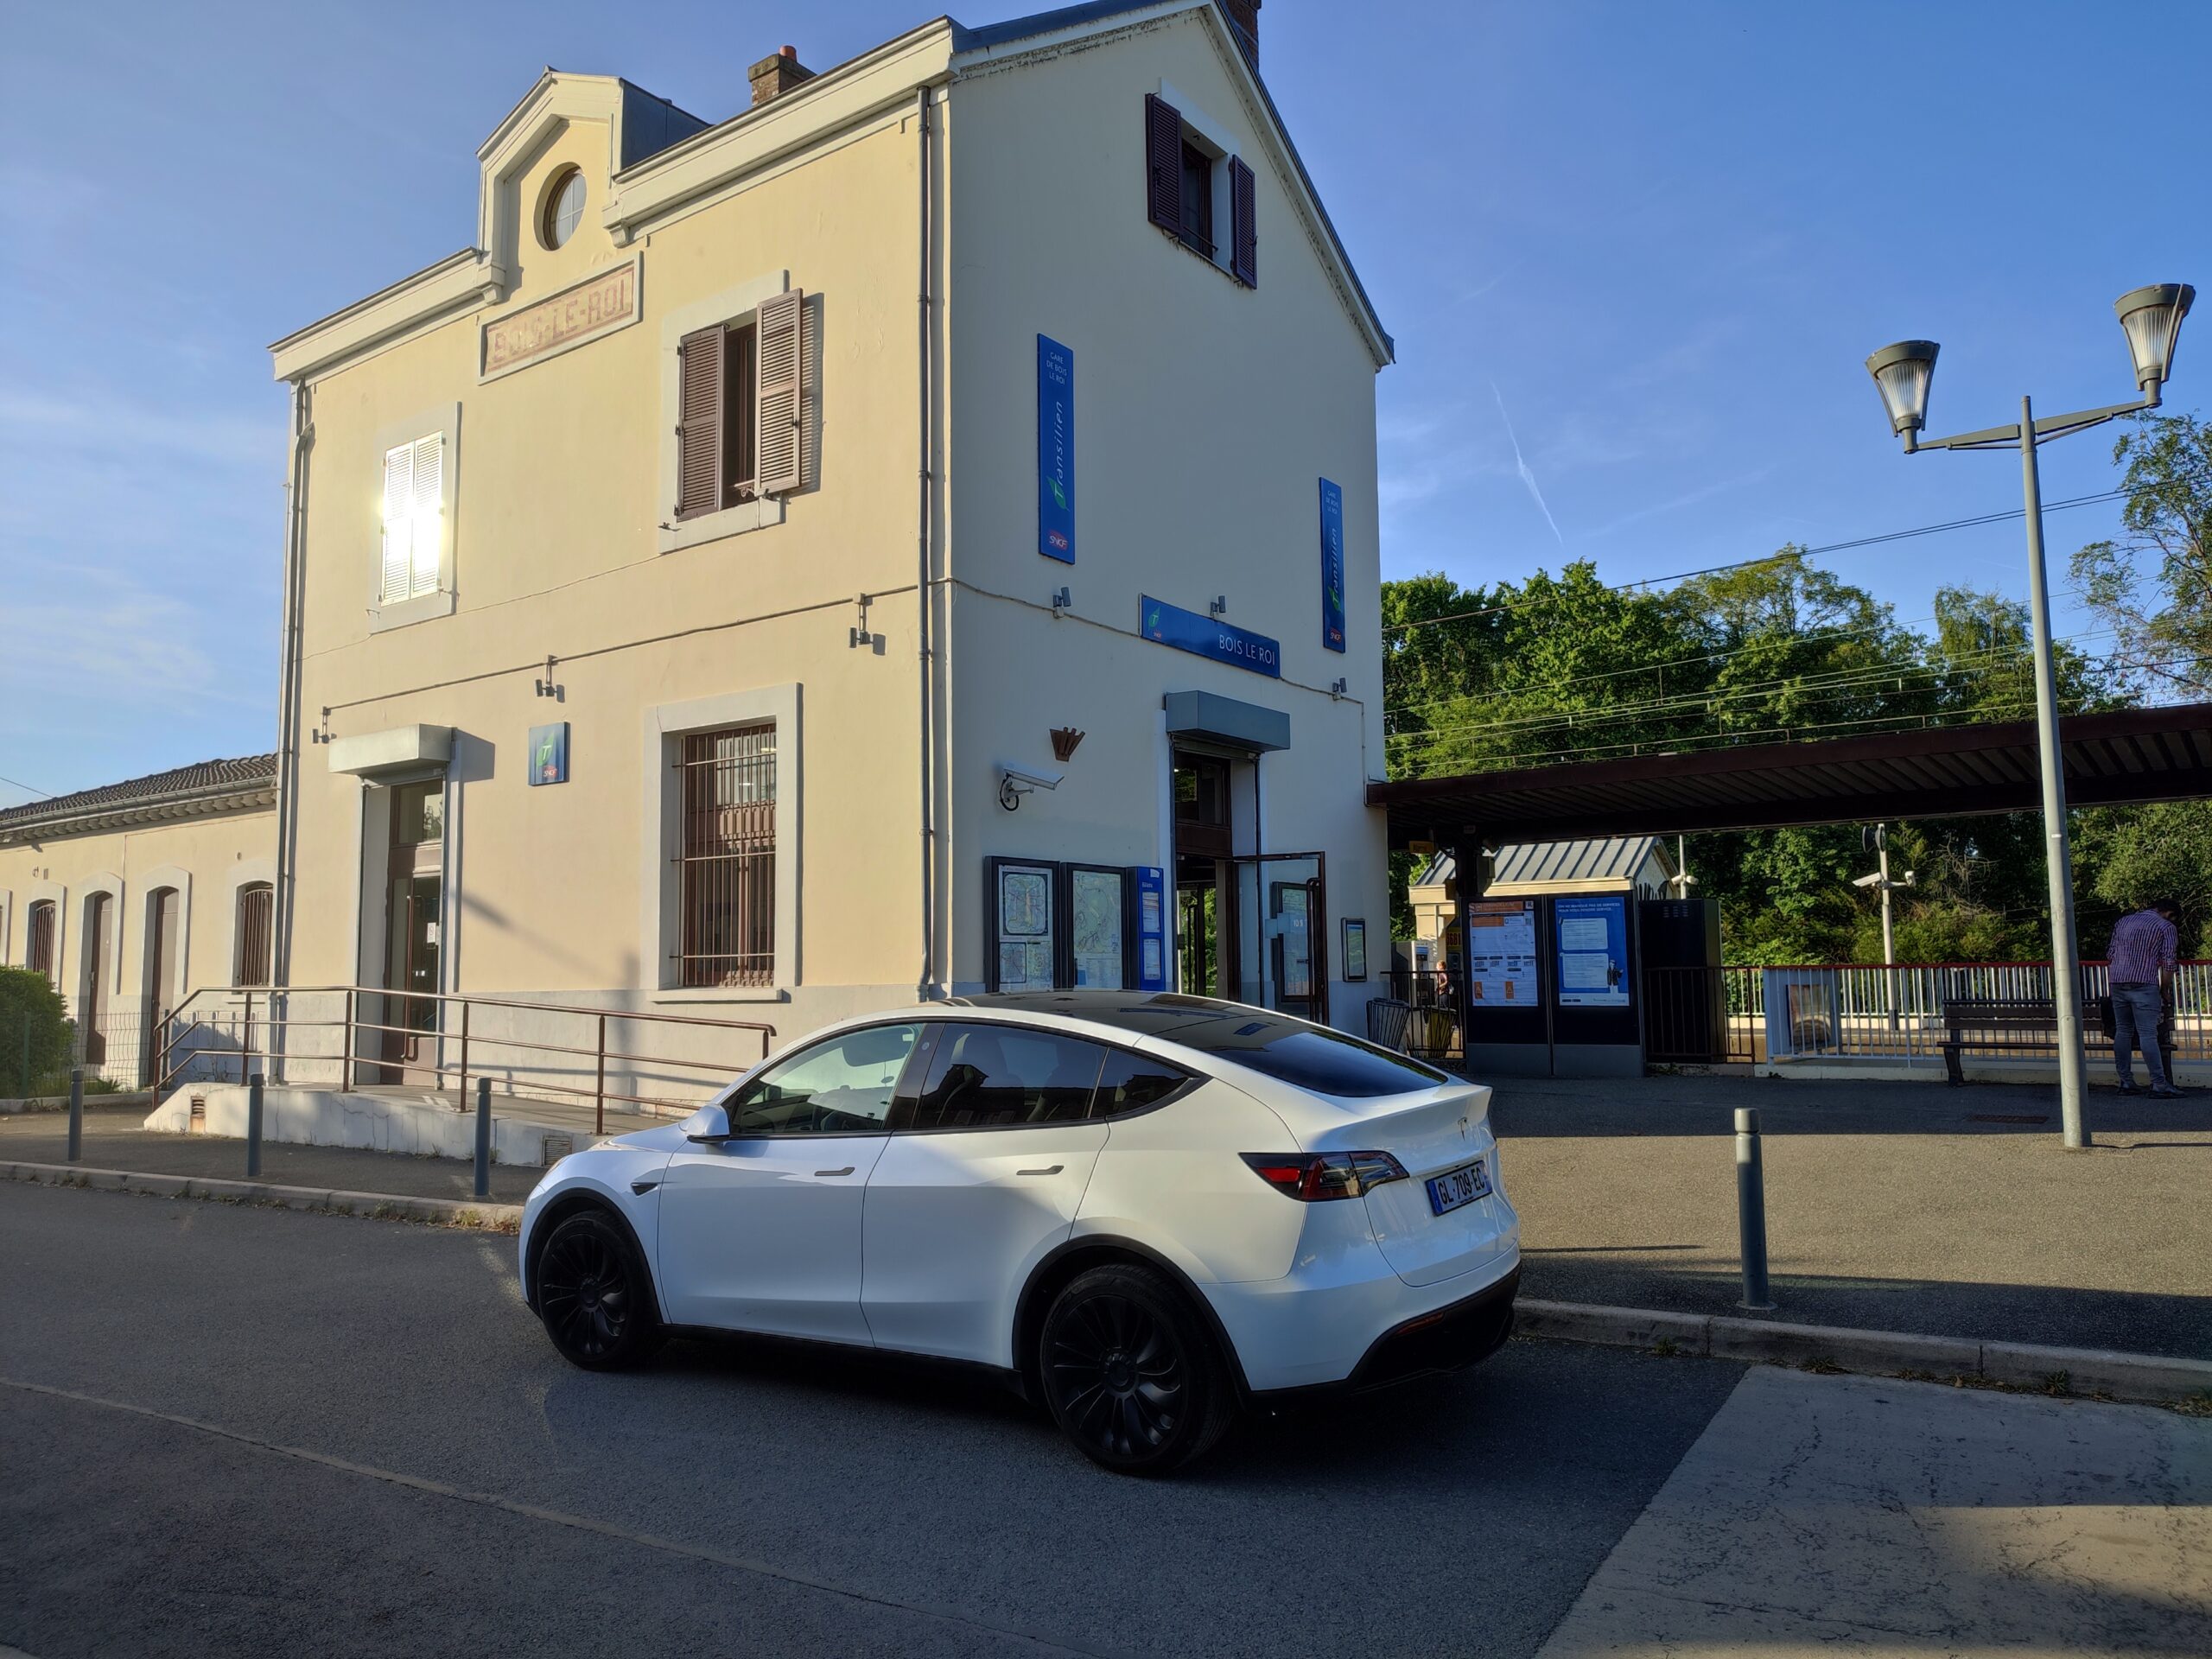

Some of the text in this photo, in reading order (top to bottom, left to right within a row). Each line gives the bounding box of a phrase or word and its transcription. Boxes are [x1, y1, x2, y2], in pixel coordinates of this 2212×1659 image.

[1046, 359, 1067, 377] DE BOIS
[1049, 371, 1065, 385] LE ROI
[1054, 400, 1064, 499] Transilien
[1049, 534, 1067, 549] SNCF
[1219, 633, 1275, 665] BOIS LE ROI
